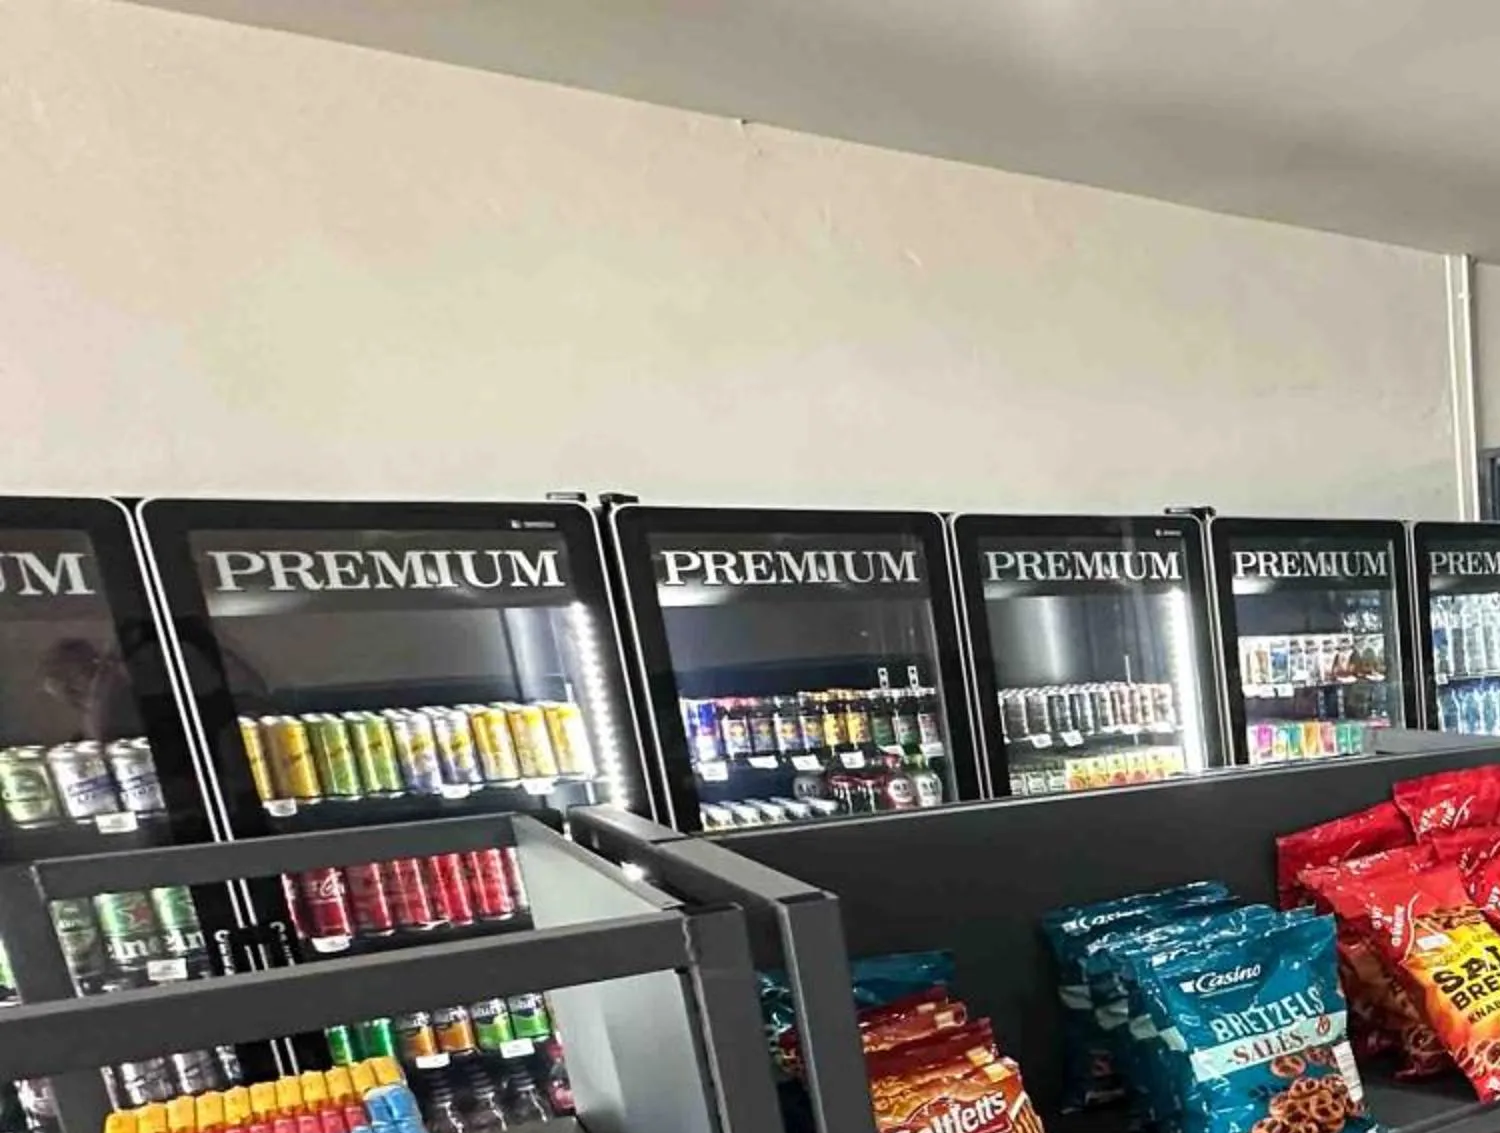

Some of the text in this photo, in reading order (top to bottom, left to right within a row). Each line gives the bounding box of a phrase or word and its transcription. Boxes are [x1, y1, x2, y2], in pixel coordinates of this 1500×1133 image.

[207, 549, 566, 593] PREMIUM
[661, 550, 921, 586] PREMIUM
[984, 551, 1182, 581] PREMIUM
[1233, 551, 1388, 577] PREMIUM
[1194, 963, 1262, 994] Casino
[1210, 986, 1326, 1043] BRETZELS
